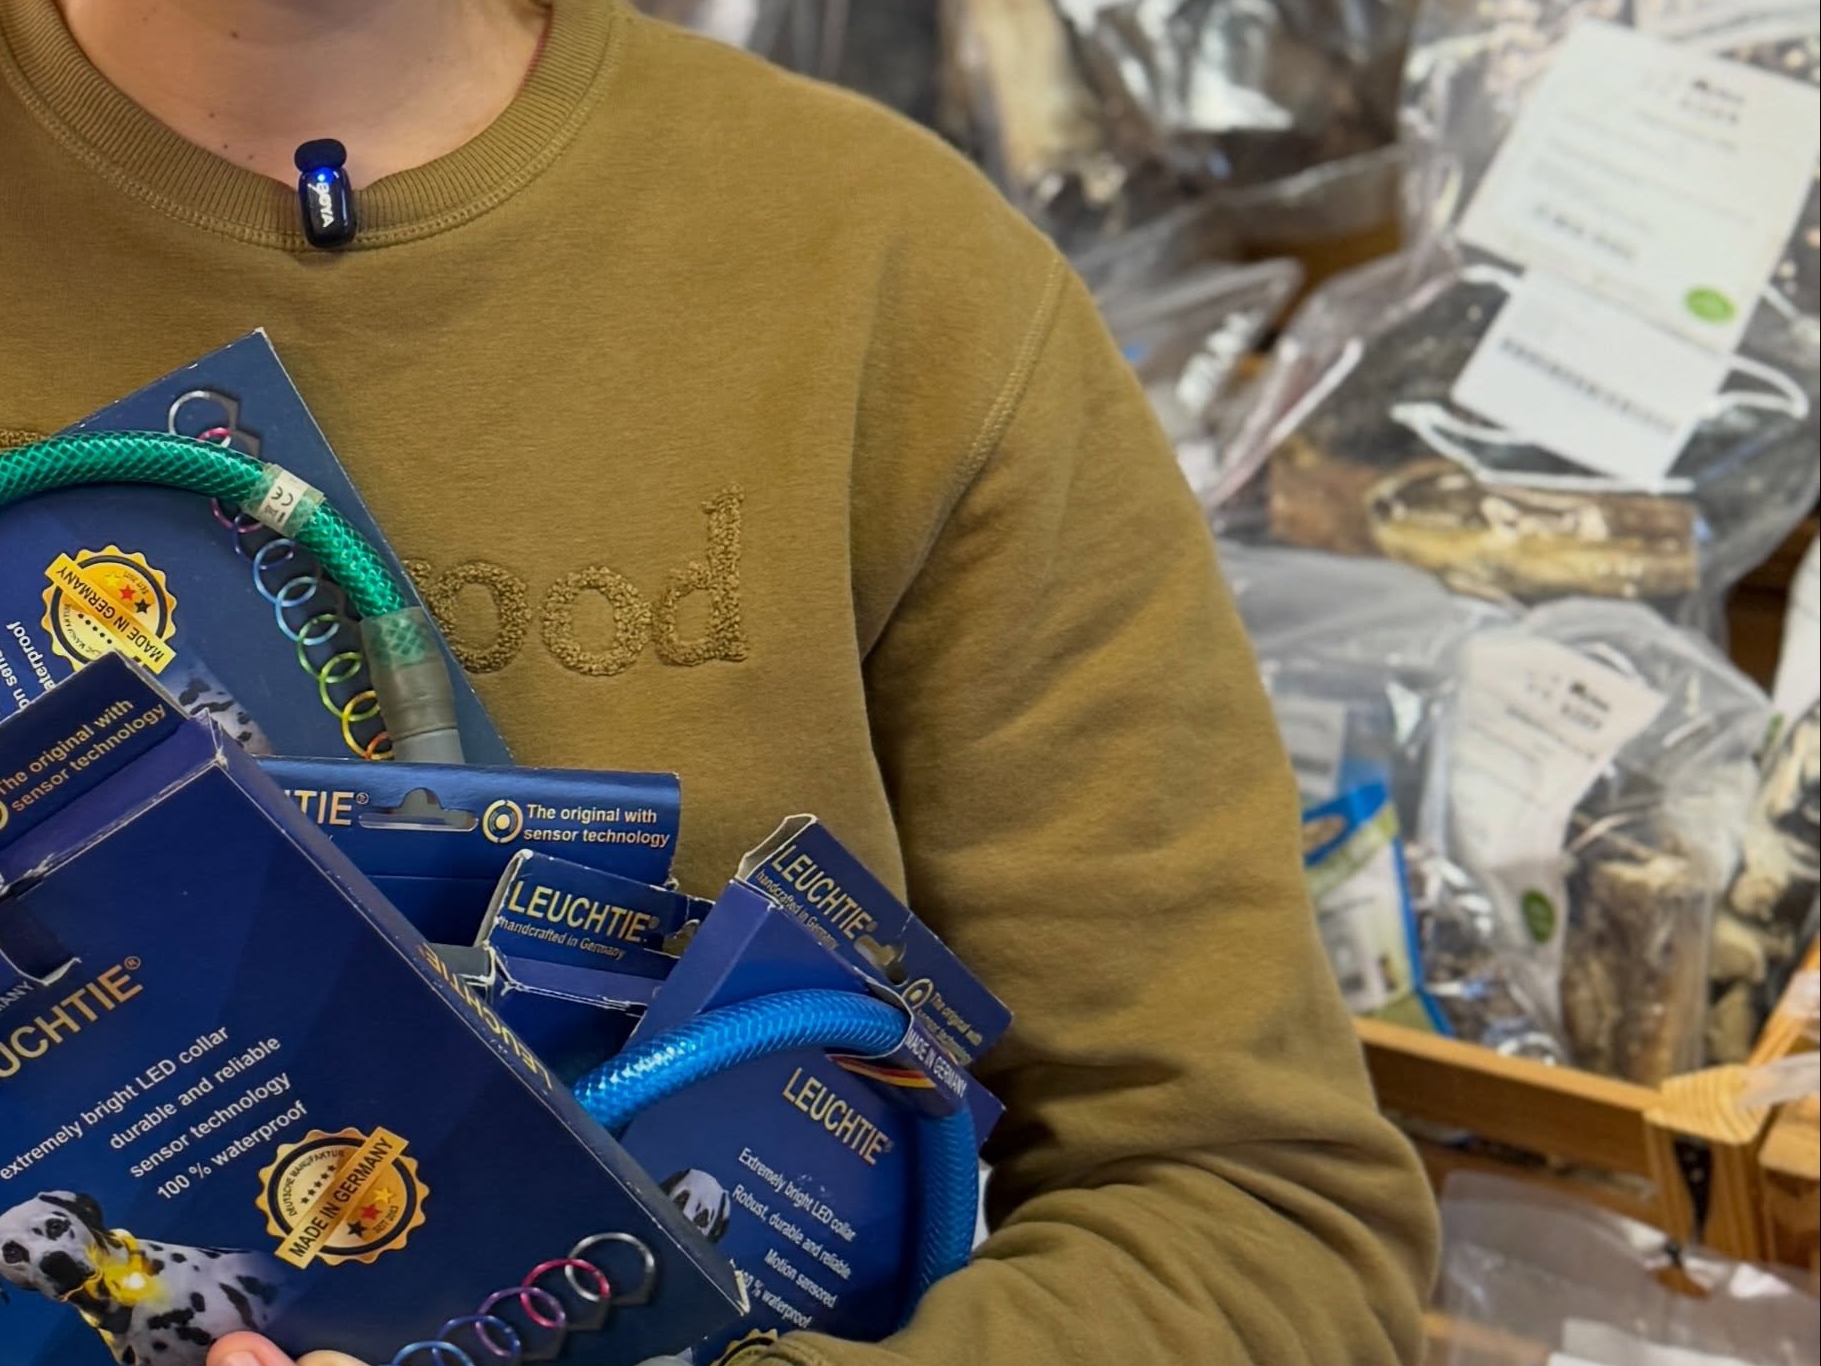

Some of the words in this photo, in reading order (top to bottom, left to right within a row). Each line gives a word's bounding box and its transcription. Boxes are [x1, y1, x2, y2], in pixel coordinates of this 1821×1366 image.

[56, 566, 116, 619] GERMANY
[414, 484, 747, 677] ood
[6, 621, 56, 692] aterproof
[113, 616, 130, 633] IN
[127, 628, 165, 663] MADE
[11, 768, 70, 812] sensor
[69, 703, 166, 771] technology
[29, 724, 94, 773] original
[94, 700, 135, 728] with
[523, 829, 578, 842] sensor
[582, 828, 671, 849] technology
[526, 804, 556, 820] The
[560, 804, 620, 826] original
[623, 807, 657, 824] with
[567, 936, 578, 947] in
[579, 937, 626, 960] Germany
[0, 1121, 84, 1181] extremely
[82, 1084, 139, 1126] bright
[135, 1058, 177, 1092] LED
[178, 1025, 230, 1066] collar
[109, 1101, 178, 1150] durable
[177, 1076, 214, 1107] and
[213, 1035, 282, 1083] reliable
[933, 1056, 967, 1098] GERMANY
[130, 1135, 189, 1179] sensor
[188, 1070, 293, 1141] technology
[156, 1173, 191, 1201] 100
[188, 1161, 213, 1180] %
[211, 1099, 309, 1168] waterproof
[288, 1216, 328, 1258] MADE
[319, 1202, 340, 1219] IN
[333, 1136, 394, 1203] GERMANY
[732, 1184, 768, 1222] Robust,
[769, 1212, 805, 1245] durable
[802, 1238, 823, 1258] and
[738, 1147, 785, 1193] Extremely
[784, 1181, 814, 1210] bright
[811, 1201, 833, 1225] LED
[764, 1248, 797, 1280] Motion
[762, 1289, 812, 1328] waterproof
